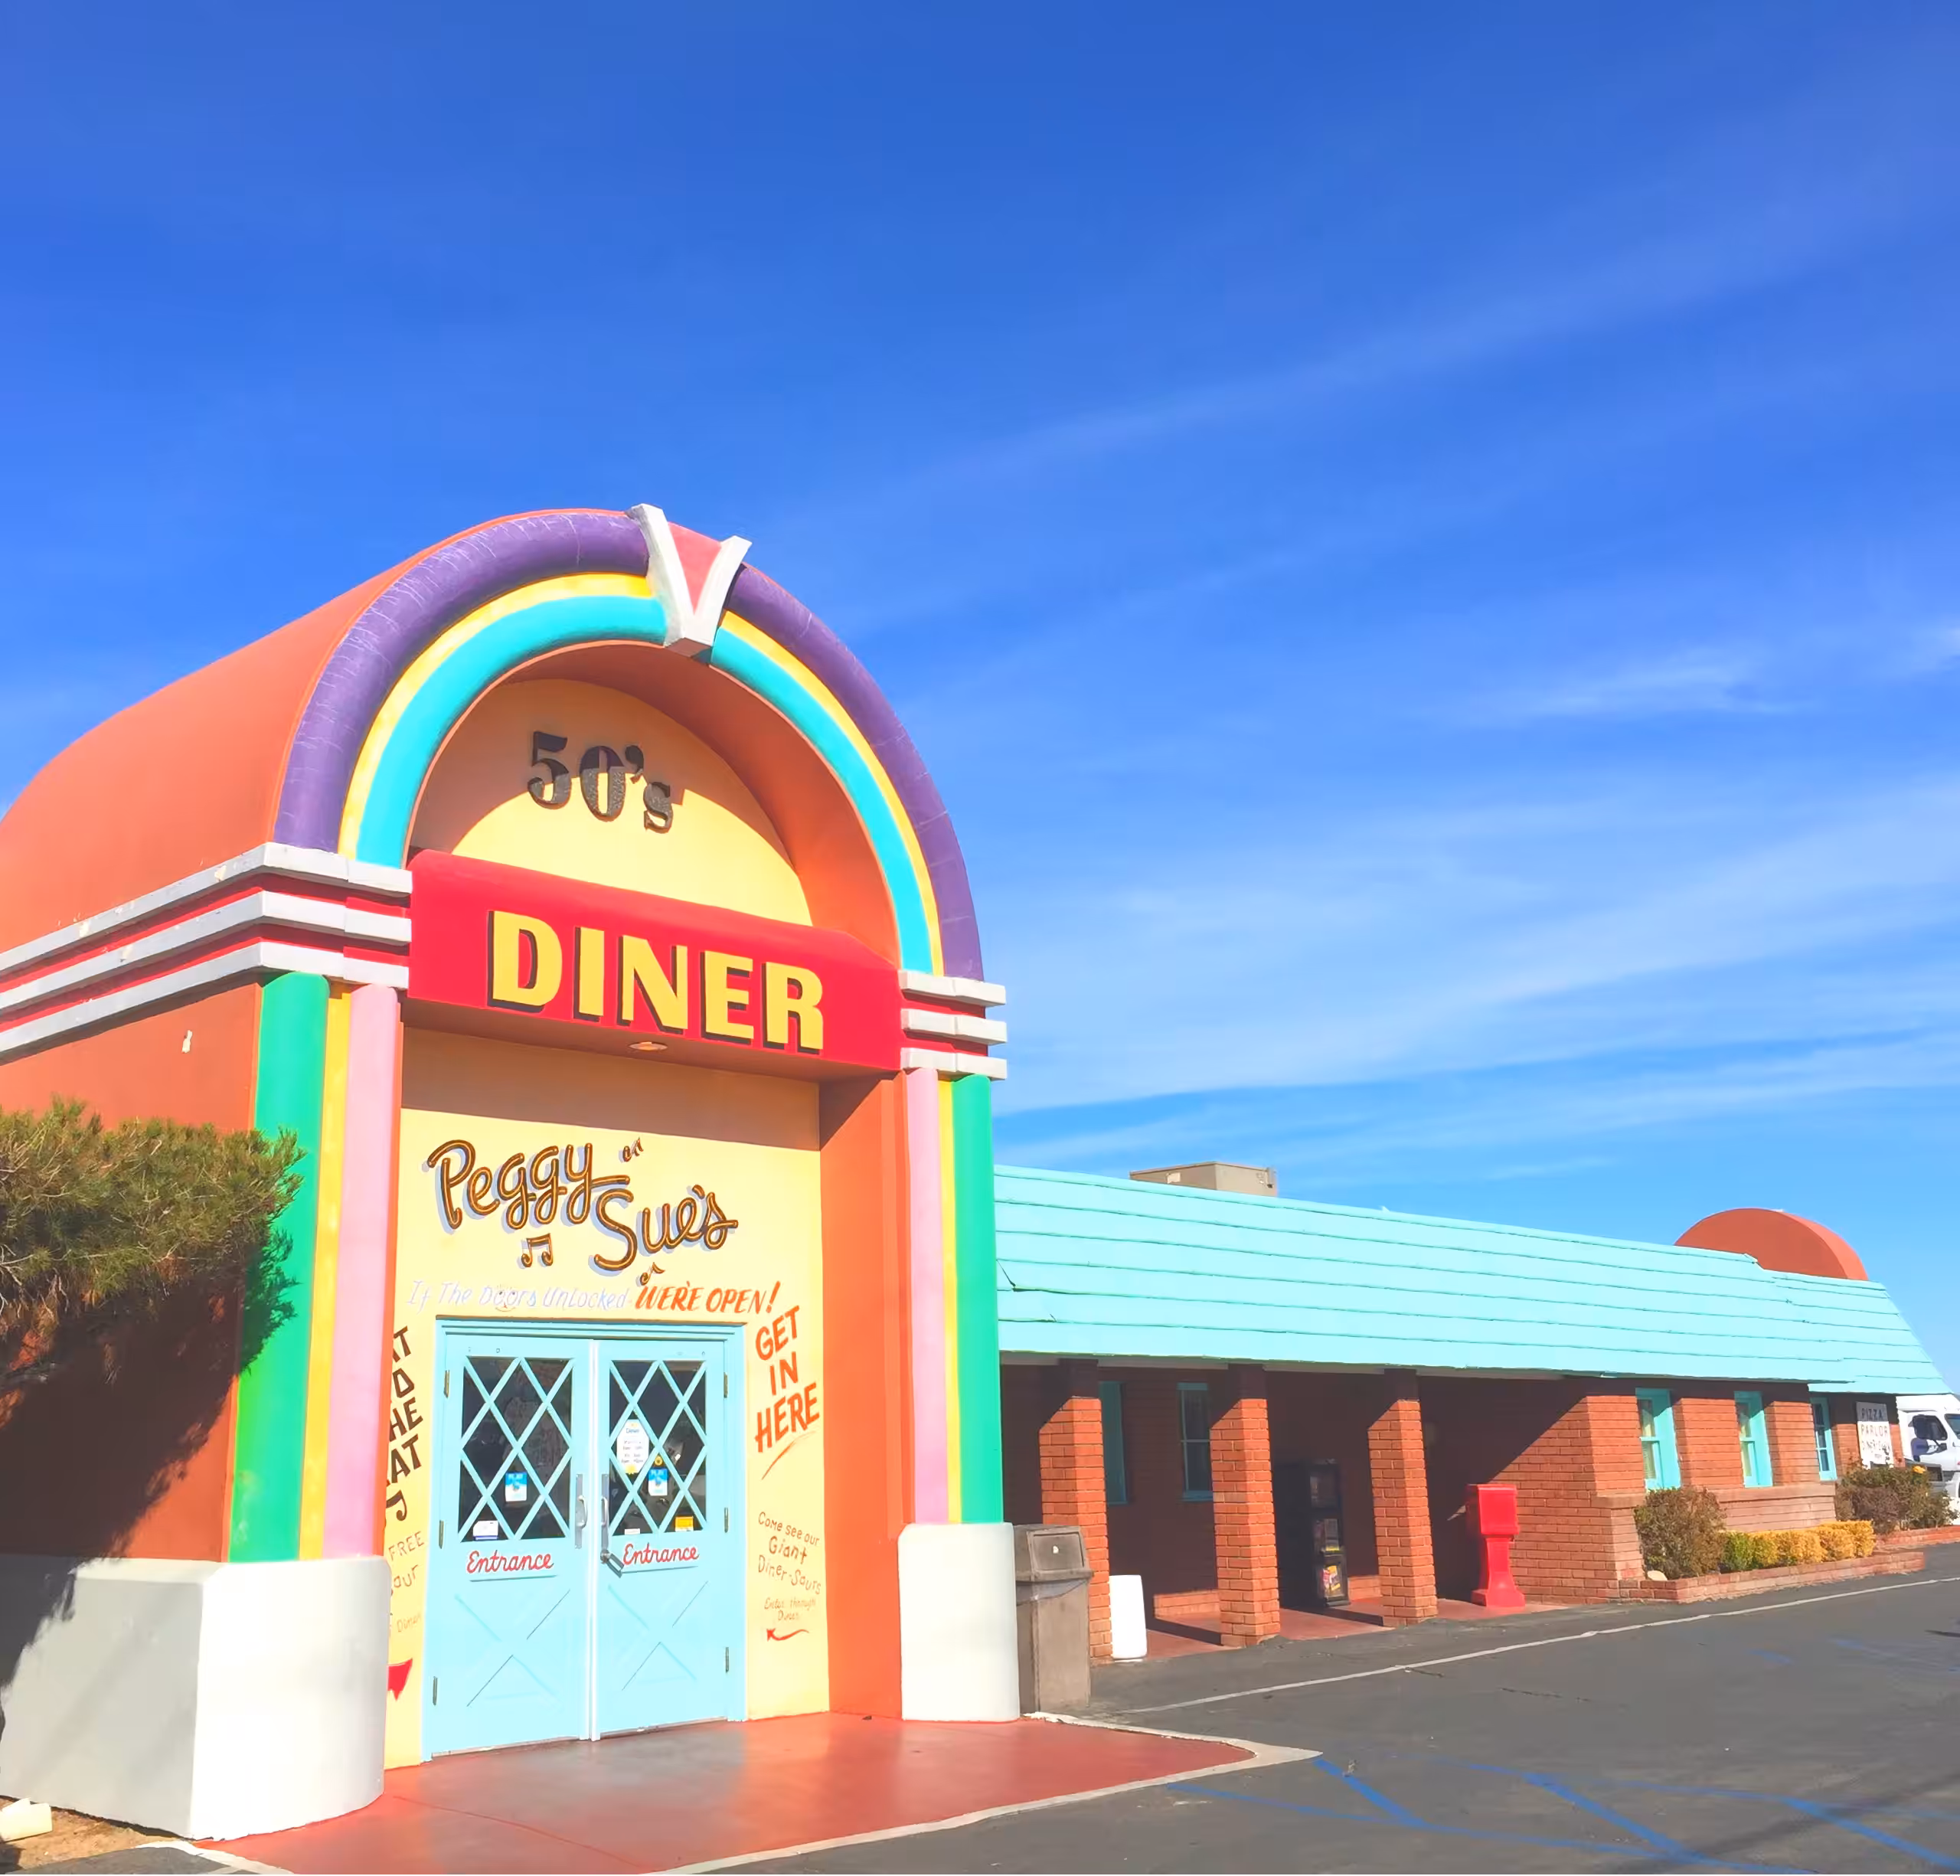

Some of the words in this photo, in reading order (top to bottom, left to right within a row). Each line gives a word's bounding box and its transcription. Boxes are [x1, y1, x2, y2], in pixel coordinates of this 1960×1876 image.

[527, 730, 674, 834] 50's
[488, 910, 824, 1054] DINER
[424, 1139, 631, 1230] Peggy
[593, 1184, 739, 1271] Sue's
[438, 1282, 472, 1306] The
[479, 1284, 537, 1308] Doors
[706, 1280, 781, 1315] OPEN!
[755, 1305, 800, 1361] GET
[769, 1351, 799, 1396] IN
[754, 1381, 820, 1453] HERE
[1861, 1407, 1884, 1421] PIZZA
[388, 1531, 425, 1561] FREE
[622, 1542, 700, 1566] Entrance
[769, 1535, 808, 1565] Giant
[785, 1525, 803, 1540] see
[804, 1533, 820, 1546] our
[466, 1549, 555, 1574] Entrance
